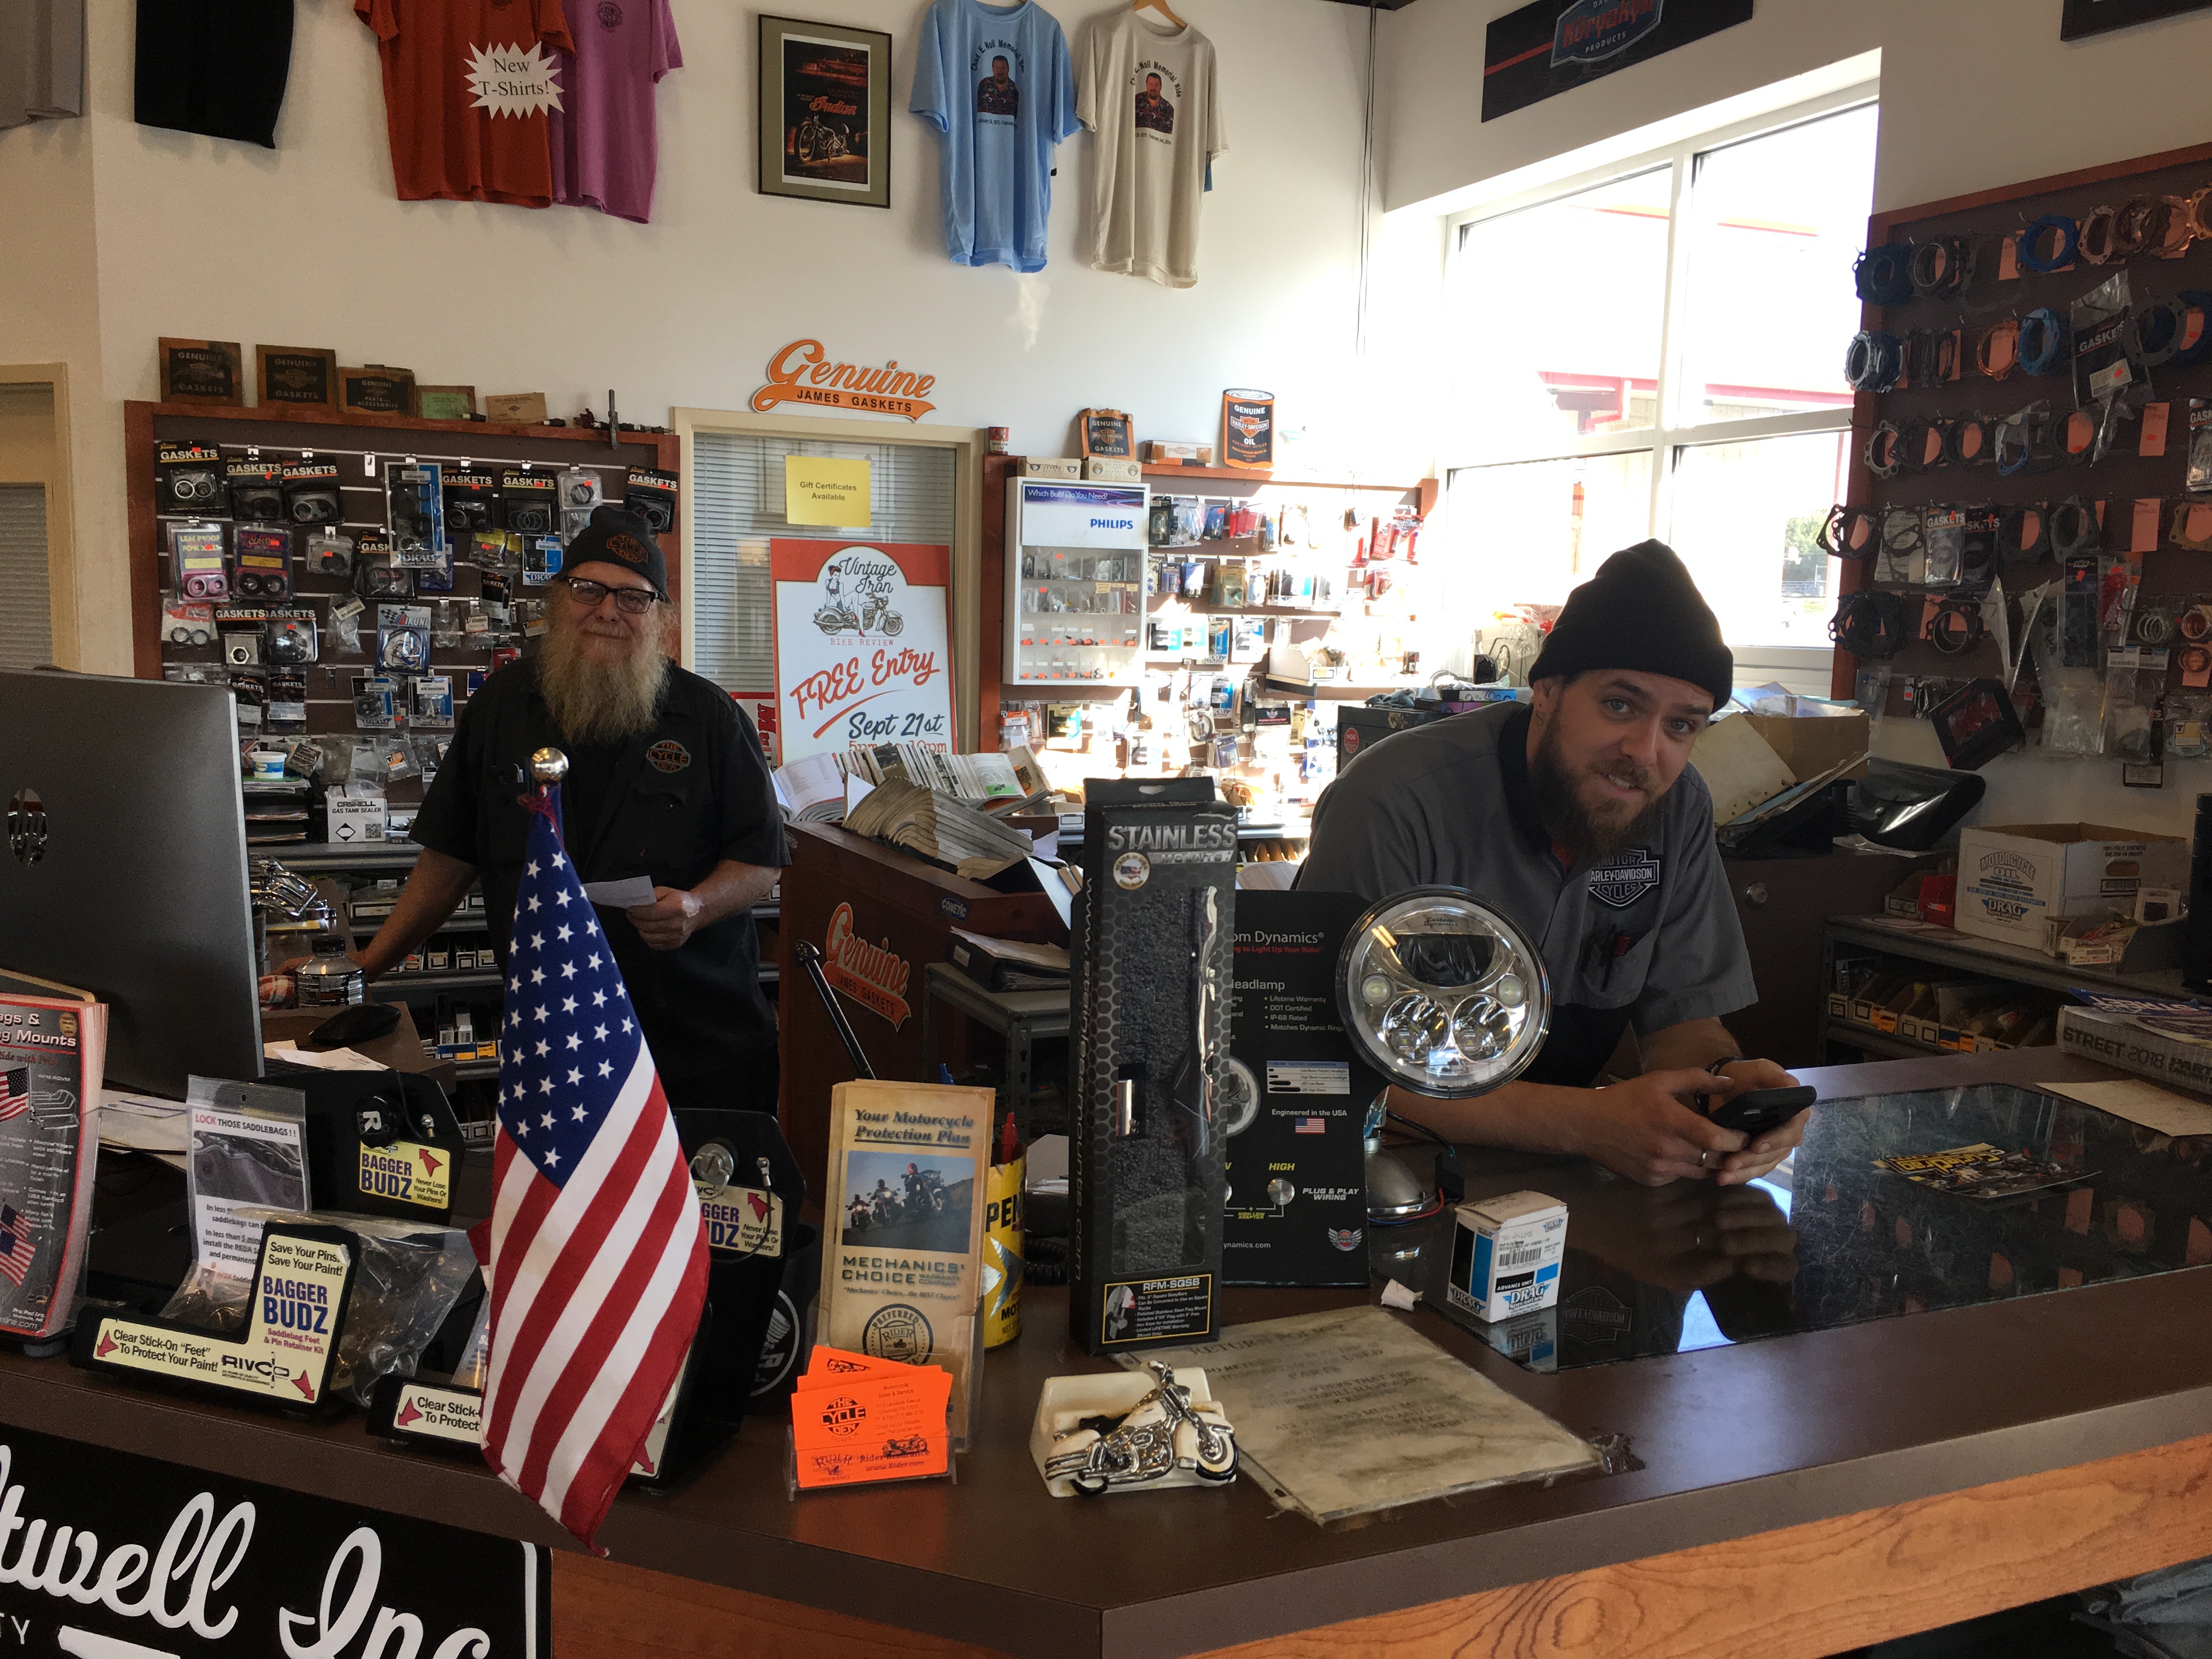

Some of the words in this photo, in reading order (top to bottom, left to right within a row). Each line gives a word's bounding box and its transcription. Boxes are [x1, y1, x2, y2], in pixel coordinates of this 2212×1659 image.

[984, 40, 995, 49] Noll
[998, 40, 1022, 59] Memorial
[1585, 31, 1626, 53] PRODUCTS
[494, 58, 530, 74] New
[1139, 60, 1150, 70] Noll
[1154, 61, 1177, 82] Memorial
[1174, 83, 1182, 98] Ride
[478, 80, 549, 97] T-Shirts!
[809, 96, 857, 116] Indian
[769, 339, 935, 399] Genuine
[797, 390, 839, 403] JAMES
[852, 397, 912, 412] GASKETS
[1234, 405, 1266, 415] GENUINE
[1232, 419, 1267, 430] HARLEY-DAVIDSON
[160, 449, 218, 460] GASKETS
[227, 464, 281, 473] GASKETS
[283, 465, 337, 477] GASKETS
[443, 476, 492, 485] GASKETS
[504, 477, 554, 487] GASKETS
[629, 474, 678, 489] GASKETS
[816, 482, 857, 491] Certificates
[812, 493, 845, 501] Available
[1090, 518, 1133, 529] PHILIPS
[839, 557, 897, 581] Vintage
[855, 575, 893, 594] Iron
[216, 609, 266, 618] GASKETS
[789, 657, 865, 720] FREE
[872, 647, 940, 686] Entry
[849, 712, 900, 740] Sept
[901, 713, 945, 736] 21st
[661, 743, 680, 751] THE
[649, 750, 688, 764] CYCLE
[1108, 823, 1235, 850] STAINLESS
[1161, 852, 1222, 864] MOUNTS
[1601, 855, 1635, 865] MOTOR
[1980, 852, 2036, 881] MOTORCYCLE
[1590, 867, 1652, 882] ARLEY-DAVIDSON
[1994, 867, 2019, 879] OIL
[1601, 883, 1637, 899] CYCLES
[942, 899, 967, 918] COMETIC
[1988, 898, 2022, 916] DRAG
[826, 902, 910, 995] Genuine
[862, 987, 895, 1014] GASKETS
[29, 1013, 40, 1025] &
[16, 1030, 76, 1047] Mounts
[2063, 1026, 2125, 1057] STREET
[2128, 1046, 2166, 1069] 2018
[1075, 878, 1092, 1281] www.stainlessmounts.com
[195, 1114, 216, 1125] LOCK
[218, 1119, 240, 1128] THOSE
[242, 1121, 288, 1136] SADDLEBAGS
[854, 1109, 888, 1122] Your
[893, 1110, 974, 1129] Motorcycle
[855, 1126, 932, 1141] Protection
[936, 1130, 970, 1143] Plan
[362, 1153, 411, 1176] BAGGER
[1269, 1163, 1295, 1171] HIGH
[362, 1169, 412, 1200] BUDZ
[414, 1184, 426, 1193] Your
[427, 1187, 438, 1195] Pins
[416, 1178, 432, 1186] Never
[433, 1181, 445, 1189] Lose
[417, 1193, 443, 1204] Washers!
[212, 1216, 247, 1228] saddlebags
[225, 1232, 240, 1240] than
[203, 1239, 222, 1248] install
[235, 1244, 252, 1254] REDA
[270, 1241, 293, 1255] Save
[295, 1245, 318, 1259] Your
[268, 1254, 291, 1268] Save
[293, 1259, 319, 1272] Your
[319, 1262, 343, 1277] Paint!
[842, 1270, 916, 1284] CHOICE
[263, 1276, 328, 1305] BAGGER
[1497, 1282, 1520, 1291] ADVANCE
[1510, 1283, 1545, 1304] DRAG
[1454, 1289, 1480, 1311] DRAG
[263, 1296, 328, 1335] BUDZ
[872, 1310, 919, 1330] PREFERRED
[114, 1329, 138, 1344] Clear
[139, 1334, 178, 1350] Stick-On
[268, 1328, 303, 1342] Saddlebag
[304, 1335, 320, 1345] Feet
[883, 1328, 915, 1341] RIDER
[264, 1336, 270, 1344] &
[272, 1338, 283, 1346] Pin
[284, 1340, 312, 1352] Retainer
[314, 1346, 324, 1355] Kit
[120, 1342, 131, 1354] To
[132, 1346, 166, 1362] Protect
[168, 1353, 189, 1365] Your
[190, 1356, 218, 1372] Paint!
[222, 1355, 290, 1377] RIVCO
[417, 1396, 446, 1412] Clear
[830, 1398, 853, 1408] THE
[425, 1411, 437, 1424] To
[439, 1414, 480, 1431] Protect
[820, 1407, 866, 1426] CYCLE
[833, 1424, 856, 1434] DEN
[860, 1454, 883, 1463] Rider
[0, 1444, 256, 1639] twell
